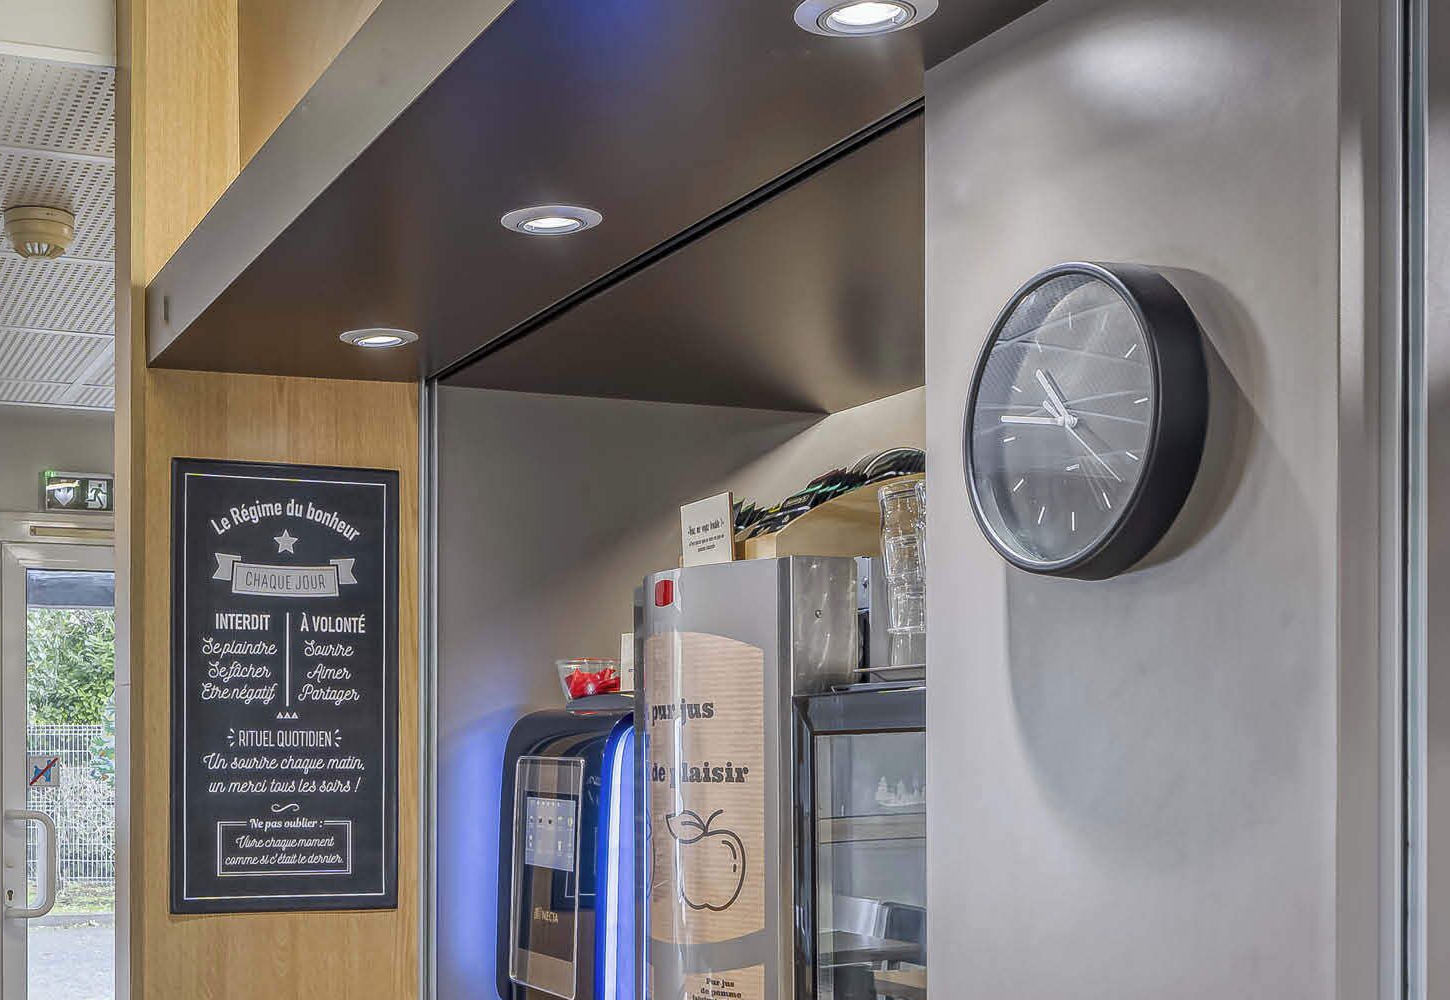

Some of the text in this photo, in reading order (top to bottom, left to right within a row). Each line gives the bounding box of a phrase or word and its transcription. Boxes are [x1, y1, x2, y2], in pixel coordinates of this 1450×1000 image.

[211, 499, 360, 541] Le Régime du bonheur
[246, 571, 326, 590] CHAQUE JOUR
[215, 613, 270, 630] INTERDIT
[301, 612, 366, 633] À VOLONTÉ
[202, 637, 277, 658] Se plaindre
[304, 640, 354, 657] Sourire
[208, 661, 271, 683] Se fâcher
[307, 664, 351, 683] Aimer
[201, 683, 278, 705] Etre négatif
[298, 683, 359, 706] Partager
[680, 698, 714, 726] jus
[238, 730, 332, 747] RITUEL QUOTIDIEN
[203, 753, 228, 770] Un
[230, 756, 278, 769] sourire
[280, 756, 325, 774] chaque
[652, 763, 666, 782] de
[209, 782, 226, 793] un
[228, 779, 266, 793] merci
[270, 778, 296, 793] tous
[299, 778, 317, 793] les
[319, 780, 351, 793] soirs
[250, 819, 263, 829] Ne
[265, 821, 282, 832] pas
[284, 819, 318, 828] oublier
[236, 835, 334, 851] Vivre chaque moment
[225, 855, 259, 865] comme
[260, 854, 269, 865] si
[298, 854, 307, 864] le
